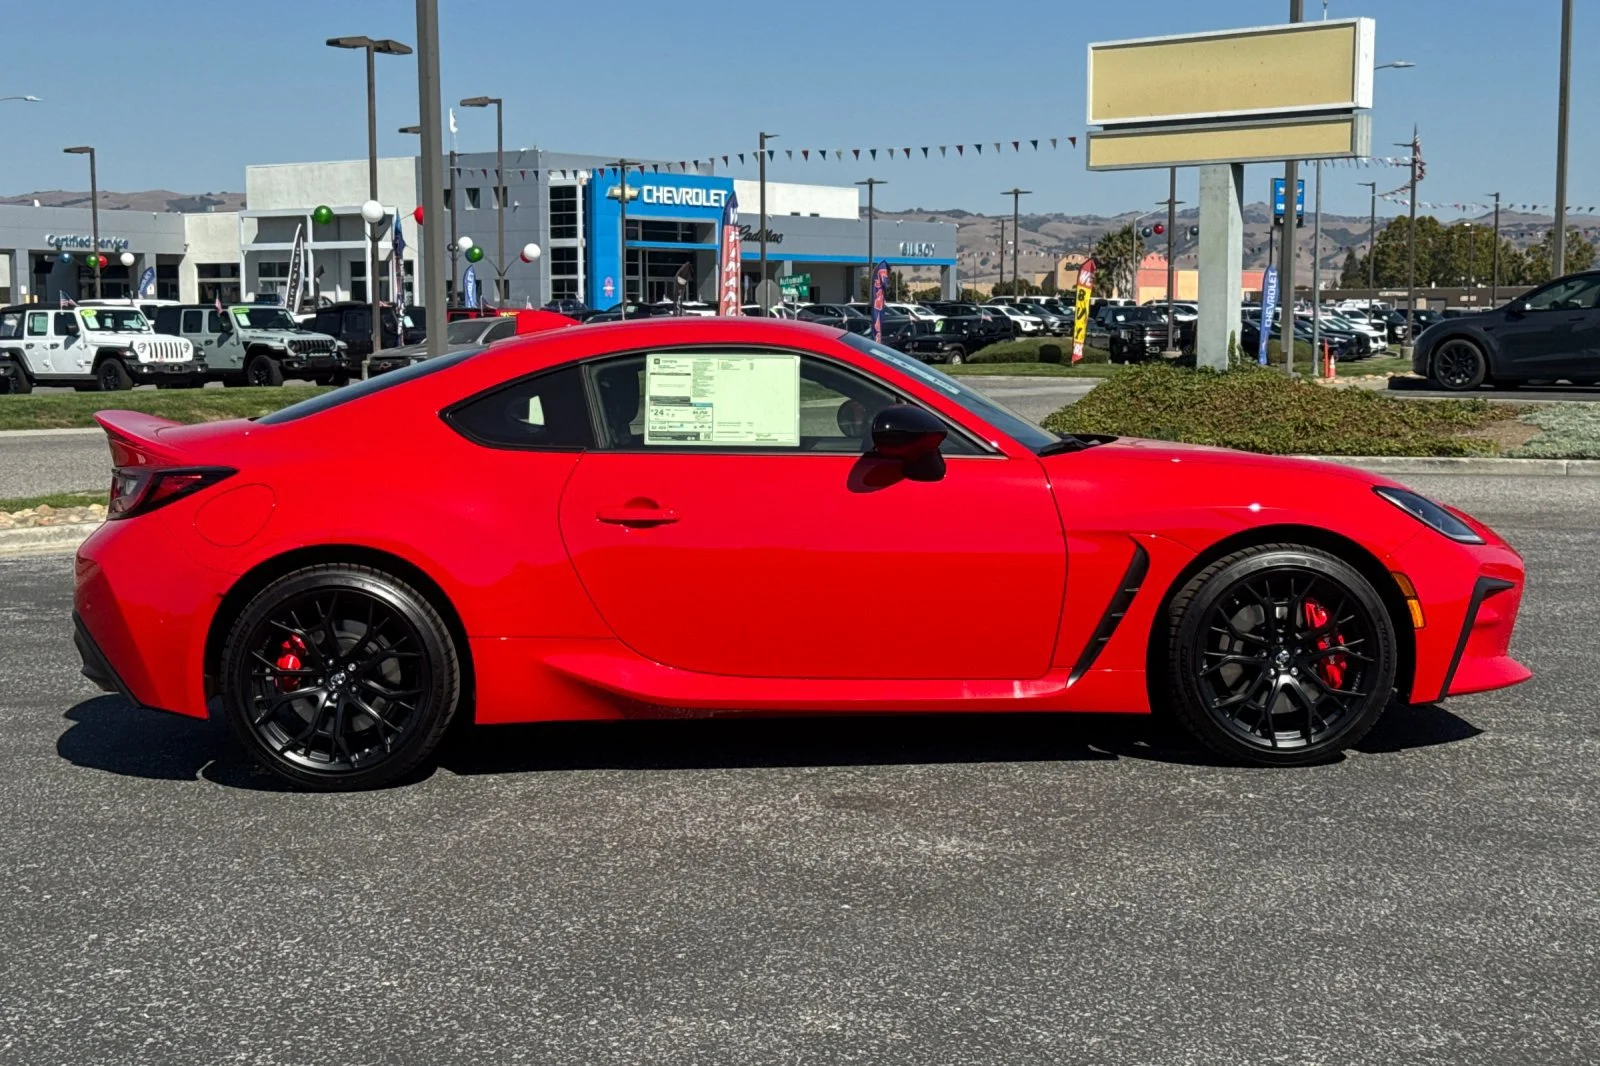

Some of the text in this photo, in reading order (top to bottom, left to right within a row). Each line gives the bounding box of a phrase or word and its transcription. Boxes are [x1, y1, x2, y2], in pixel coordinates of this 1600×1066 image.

[643, 185, 728, 208] CHEVROLET
[45, 233, 129, 250] Certified ervice
[737, 224, 783, 244] Cadllac
[900, 242, 936, 257] GILROY
[1265, 271, 1278, 328] CHEVROLET
[1075, 288, 1087, 340] BUY
